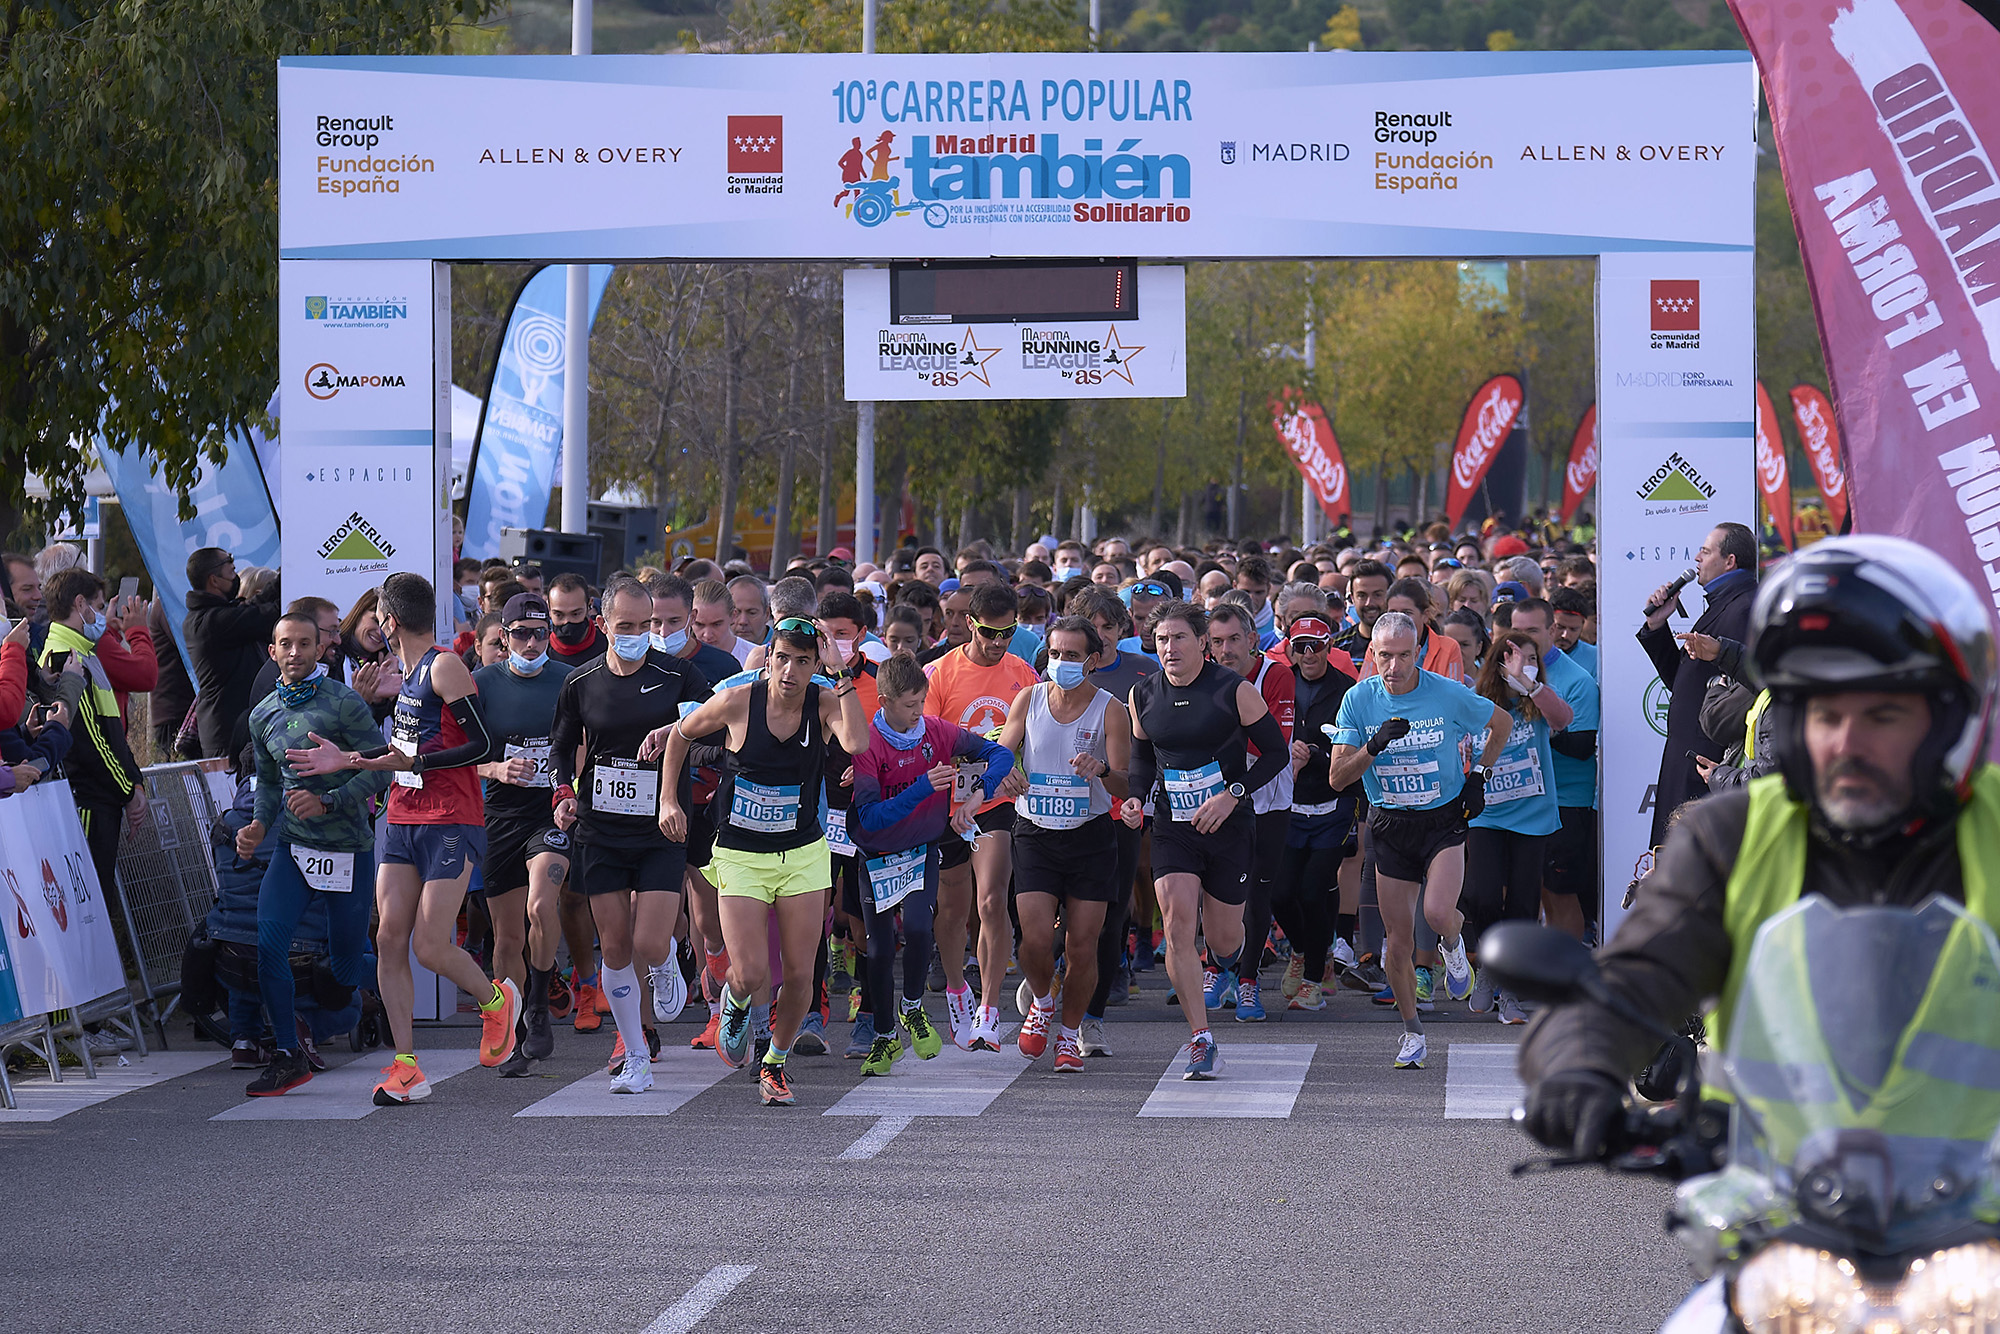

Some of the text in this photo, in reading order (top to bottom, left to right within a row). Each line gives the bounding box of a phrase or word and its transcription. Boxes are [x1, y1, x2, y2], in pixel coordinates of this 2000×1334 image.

[1041, 79, 1192, 121] POPULAR
[316, 115, 394, 131] Renault
[1375, 111, 1452, 127] Renault
[316, 131, 379, 150] Group
[936, 134, 1035, 154] Madrid
[1374, 128, 1437, 146] Group
[479, 147, 683, 164] ALLEN & OVERY
[1252, 143, 1350, 162] MADRID
[1375, 151, 1493, 169] Fundación
[1520, 145, 1725, 161] ALLEN & OVERY
[317, 154, 435, 173] Fundación
[904, 133, 1191, 200] también
[317, 176, 400, 197] España
[727, 176, 784, 185] Comunidad
[1375, 172, 1458, 193] España
[727, 185, 783, 194] de Madrid
[950, 203, 1071, 213] POR LA INCLUSIÓN Y LA ACCESIBILIDAD
[1073, 202, 1191, 223] Solidario
[950, 214, 1071, 223] DE LAS PERSONAS CON DISCAPACIDAD
[330, 300, 407, 319] TAMBIÉN
[1651, 333, 1700, 341] Comunidad
[1651, 341, 1700, 349] de Madrid
[879, 342, 957, 356] RUNNING
[1022, 340, 1100, 354] RUNNING
[879, 355, 957, 371] LEAGUE
[1022, 353, 1100, 369] LEAGUE
[336, 375, 406, 387] MAPOMA
[918, 371, 958, 387] by as
[1062, 369, 1102, 385] by as
[1683, 379, 1734, 387] EMPRESARIAL
[1453, 386, 1514, 489] Coca-Cola
[320, 467, 412, 482] ESPACIO
[1636, 452, 1717, 500] LEROY MERLIN
[1655, 507, 1670, 515] vida
[1690, 502, 1708, 511] ideas
[316, 511, 396, 559] LEROY MERLIN
[336, 565, 350, 575] vida
[370, 562, 388, 570] ideas
[972, 699, 1006, 710] MAPOMA
[1409, 717, 1444, 730] POPULAR
[608, 780, 637, 800] 185
[1392, 774, 1425, 792] 1131
[743, 800, 784, 821] 1055
[1040, 797, 1075, 816] 1189
[305, 857, 334, 876] 210
[884, 868, 914, 896] 1085
